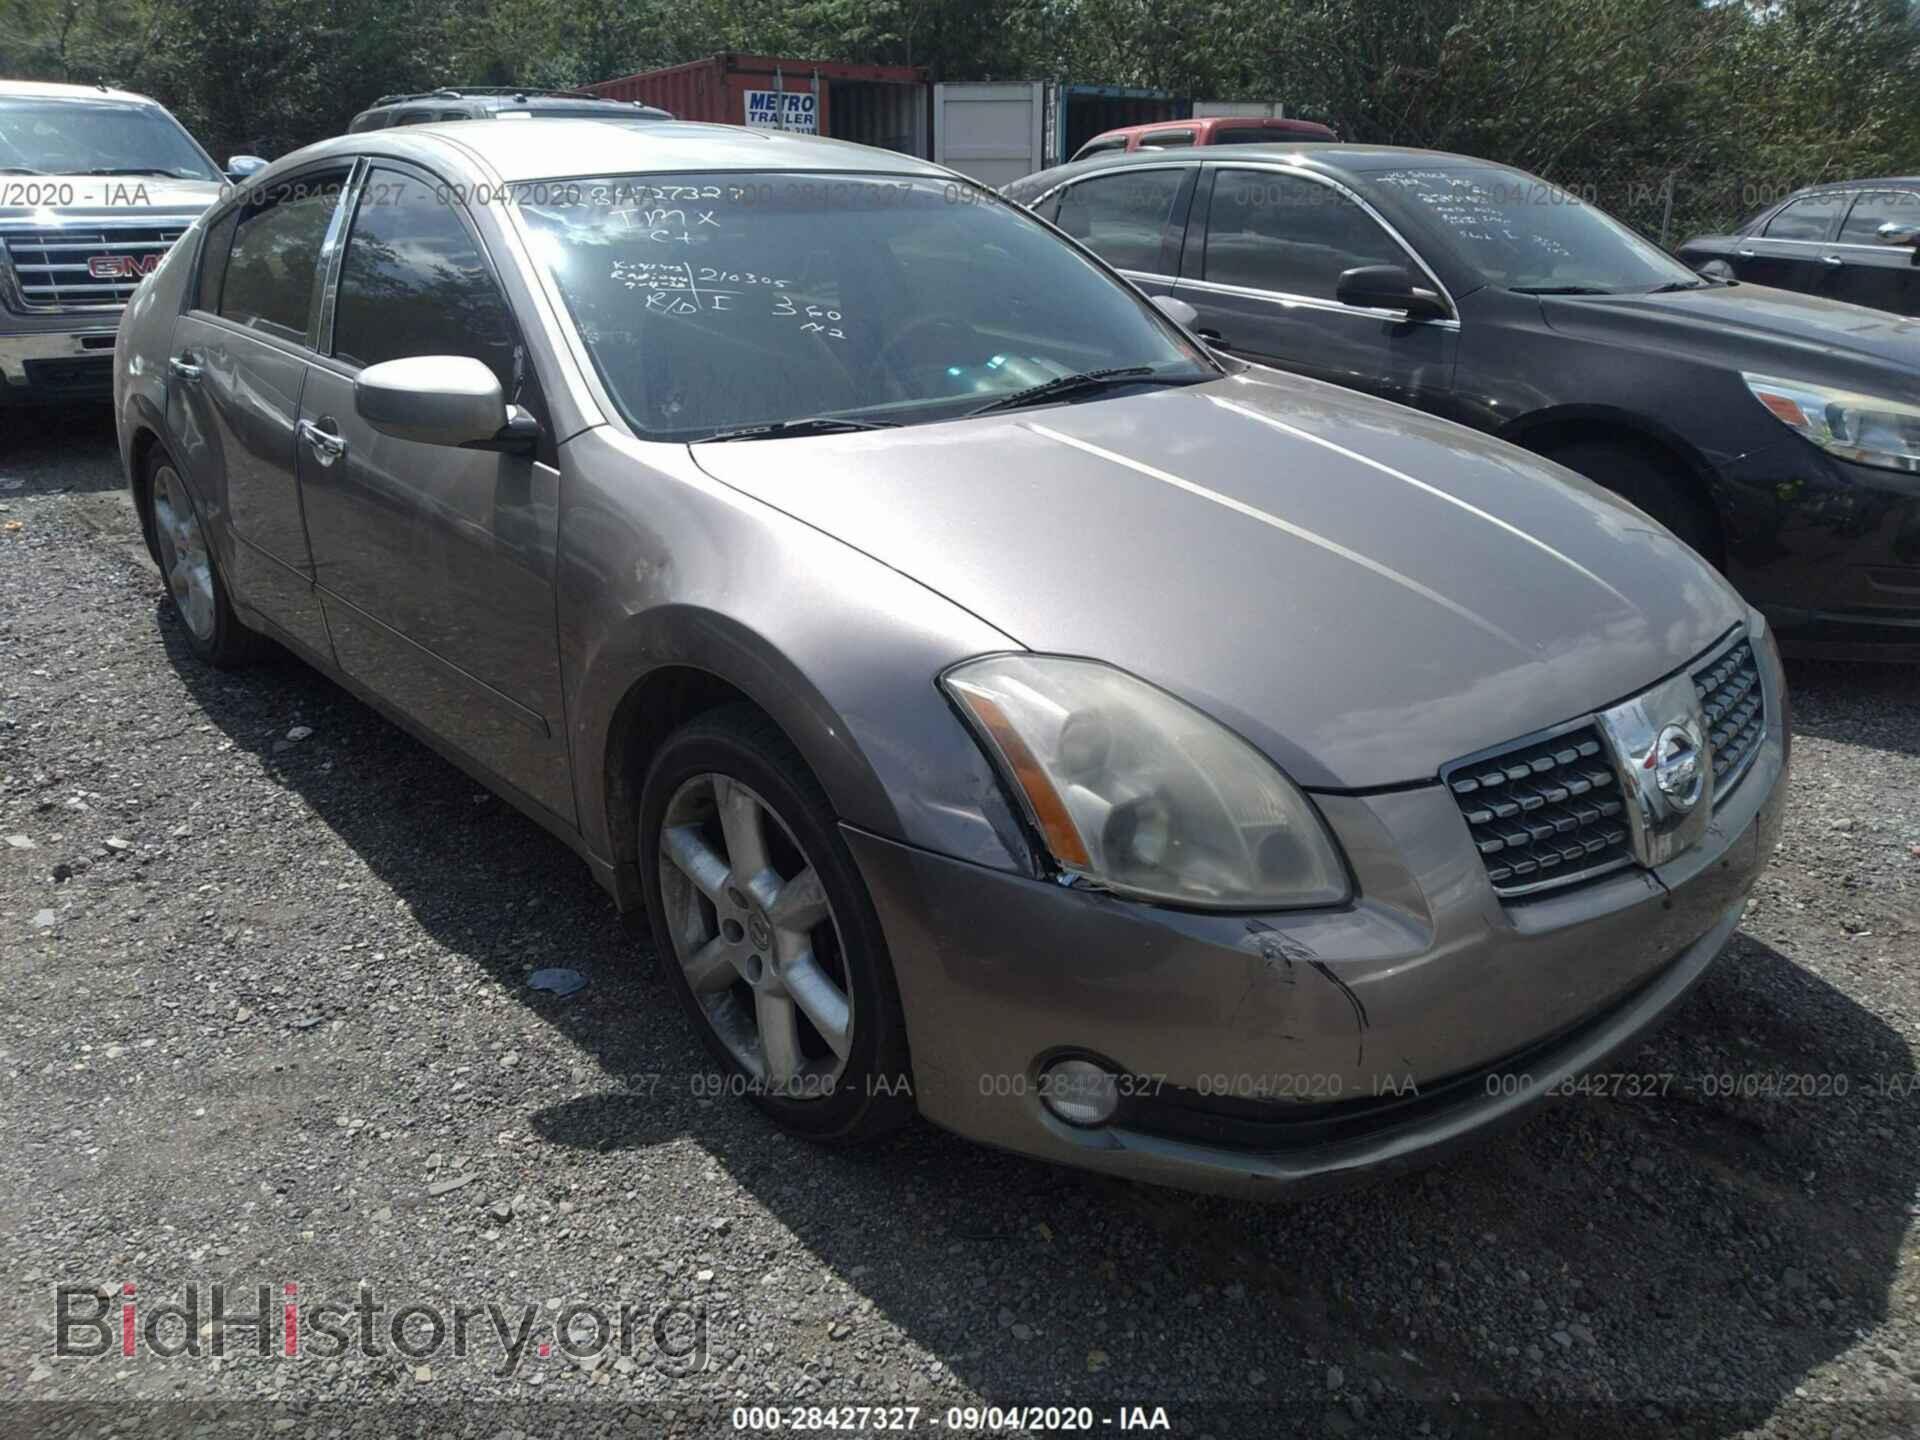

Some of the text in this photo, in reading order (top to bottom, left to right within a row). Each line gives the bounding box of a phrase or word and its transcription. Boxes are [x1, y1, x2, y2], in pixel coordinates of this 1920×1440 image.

[750, 93, 814, 112] METRO
[749, 111, 813, 125] TRALER
[88, 256, 158, 279] GM
